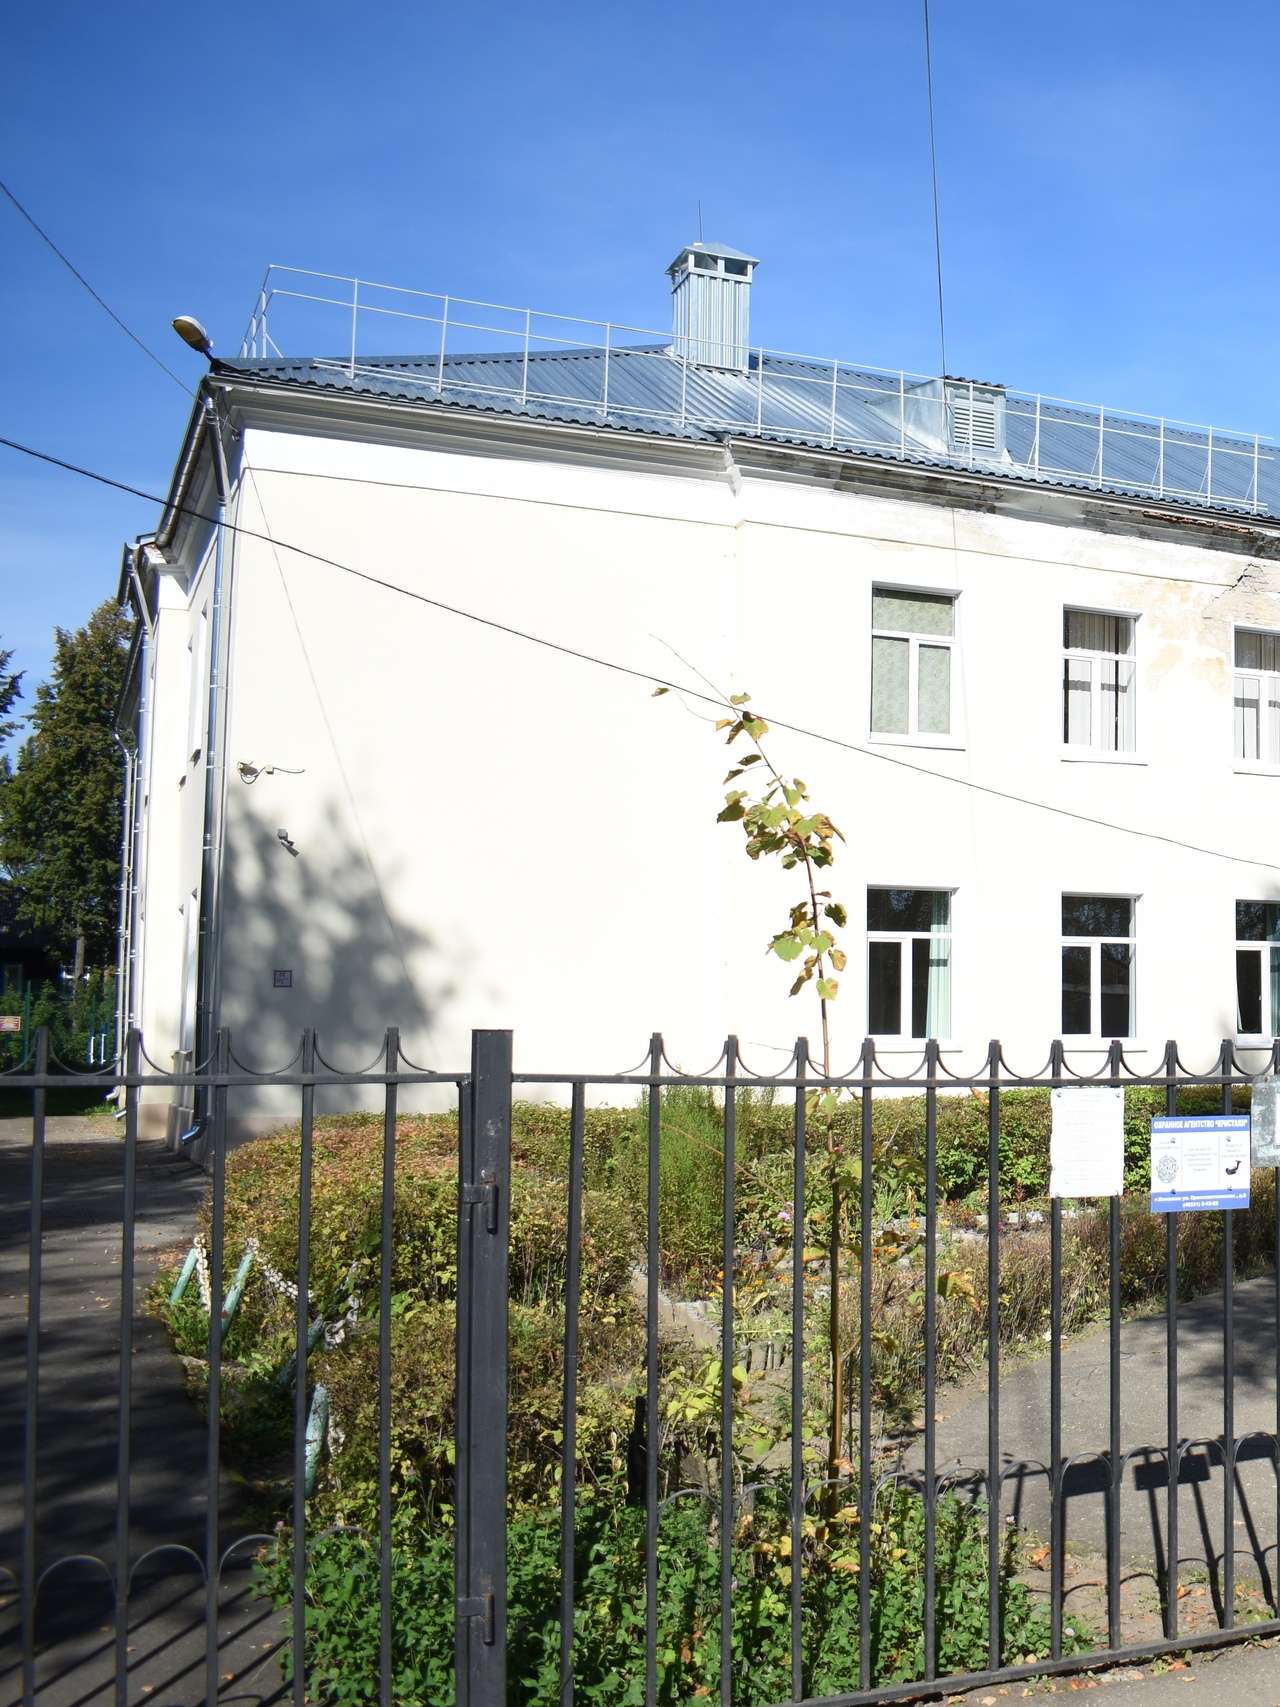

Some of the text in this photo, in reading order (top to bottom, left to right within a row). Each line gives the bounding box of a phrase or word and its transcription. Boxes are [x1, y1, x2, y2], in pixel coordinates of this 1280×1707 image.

[1154, 1119, 1248, 1129] ОХРАННОЕ АГЕНТСТВО "КРИСТАЛЛ"
